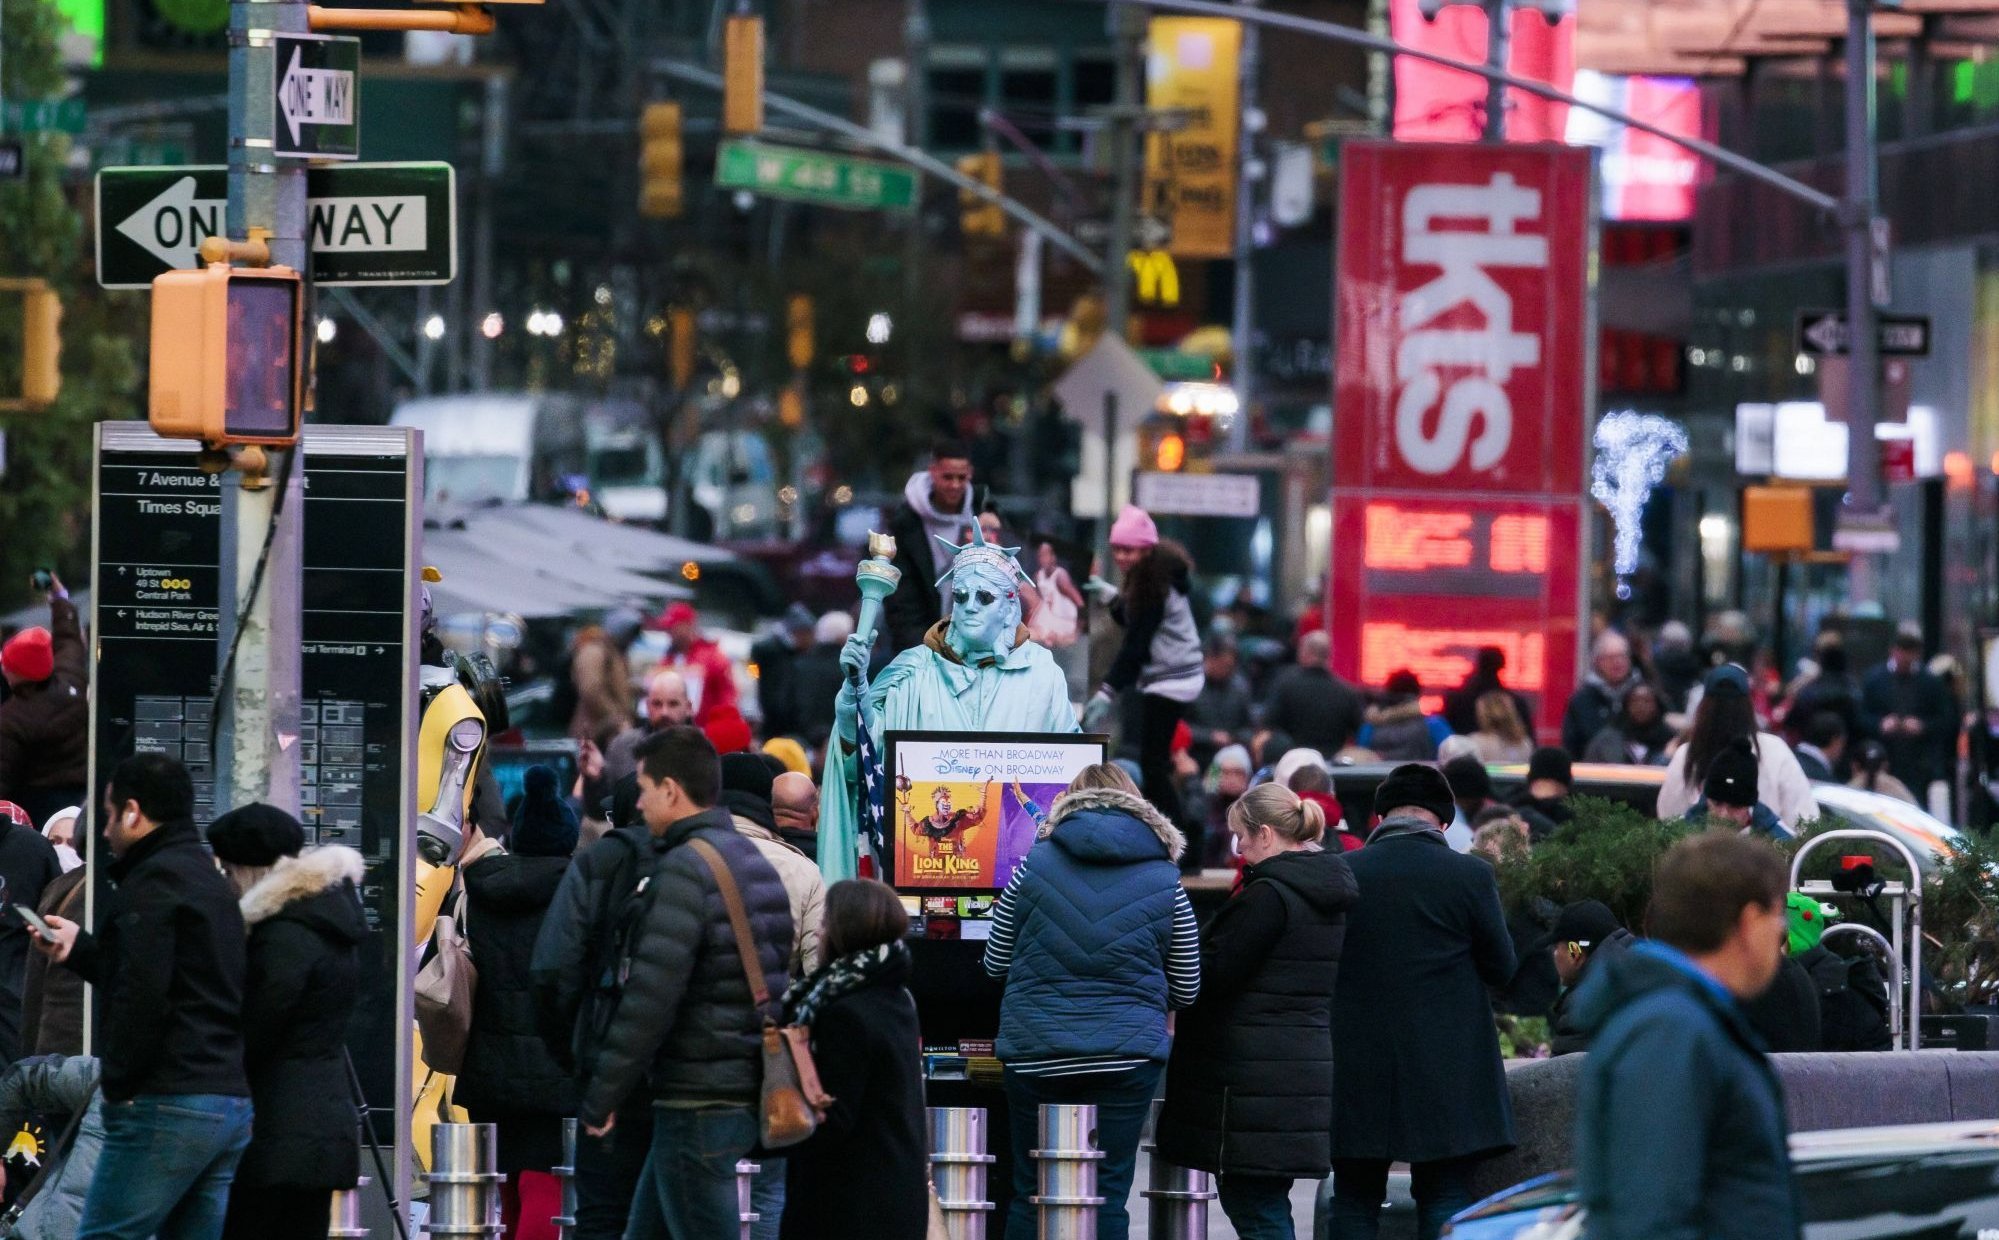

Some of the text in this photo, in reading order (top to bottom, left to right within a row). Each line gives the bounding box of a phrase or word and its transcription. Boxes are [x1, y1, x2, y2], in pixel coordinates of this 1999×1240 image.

[287, 74, 350, 120] ONE WAY
[154, 202, 405, 249] ON WAY
[1395, 171, 1549, 475] tkts
[137, 472, 148, 485] 7
[150, 472, 206, 487] Avenue
[208, 473, 221, 487] &
[137, 499, 182, 514] Times
[136, 567, 172, 578] Uptown
[136, 580, 148, 588] 49
[149, 580, 160, 588] St
[136, 590, 192, 600] Central Park
[136, 610, 170, 619] Hudson
[171, 611, 196, 620] River
[136, 622, 170, 632] Intrepid
[192, 622, 205, 631] Air
[206, 623, 214, 632] &
[318, 645, 355, 654] Terminal
[940, 748, 1065, 760] MORE THAN BROADWAY
[985, 764, 1003, 775] ON
[1006, 764, 1065, 775] BROADWAY
[938, 842, 953, 851] THE
[913, 854, 979, 874] LION KING
